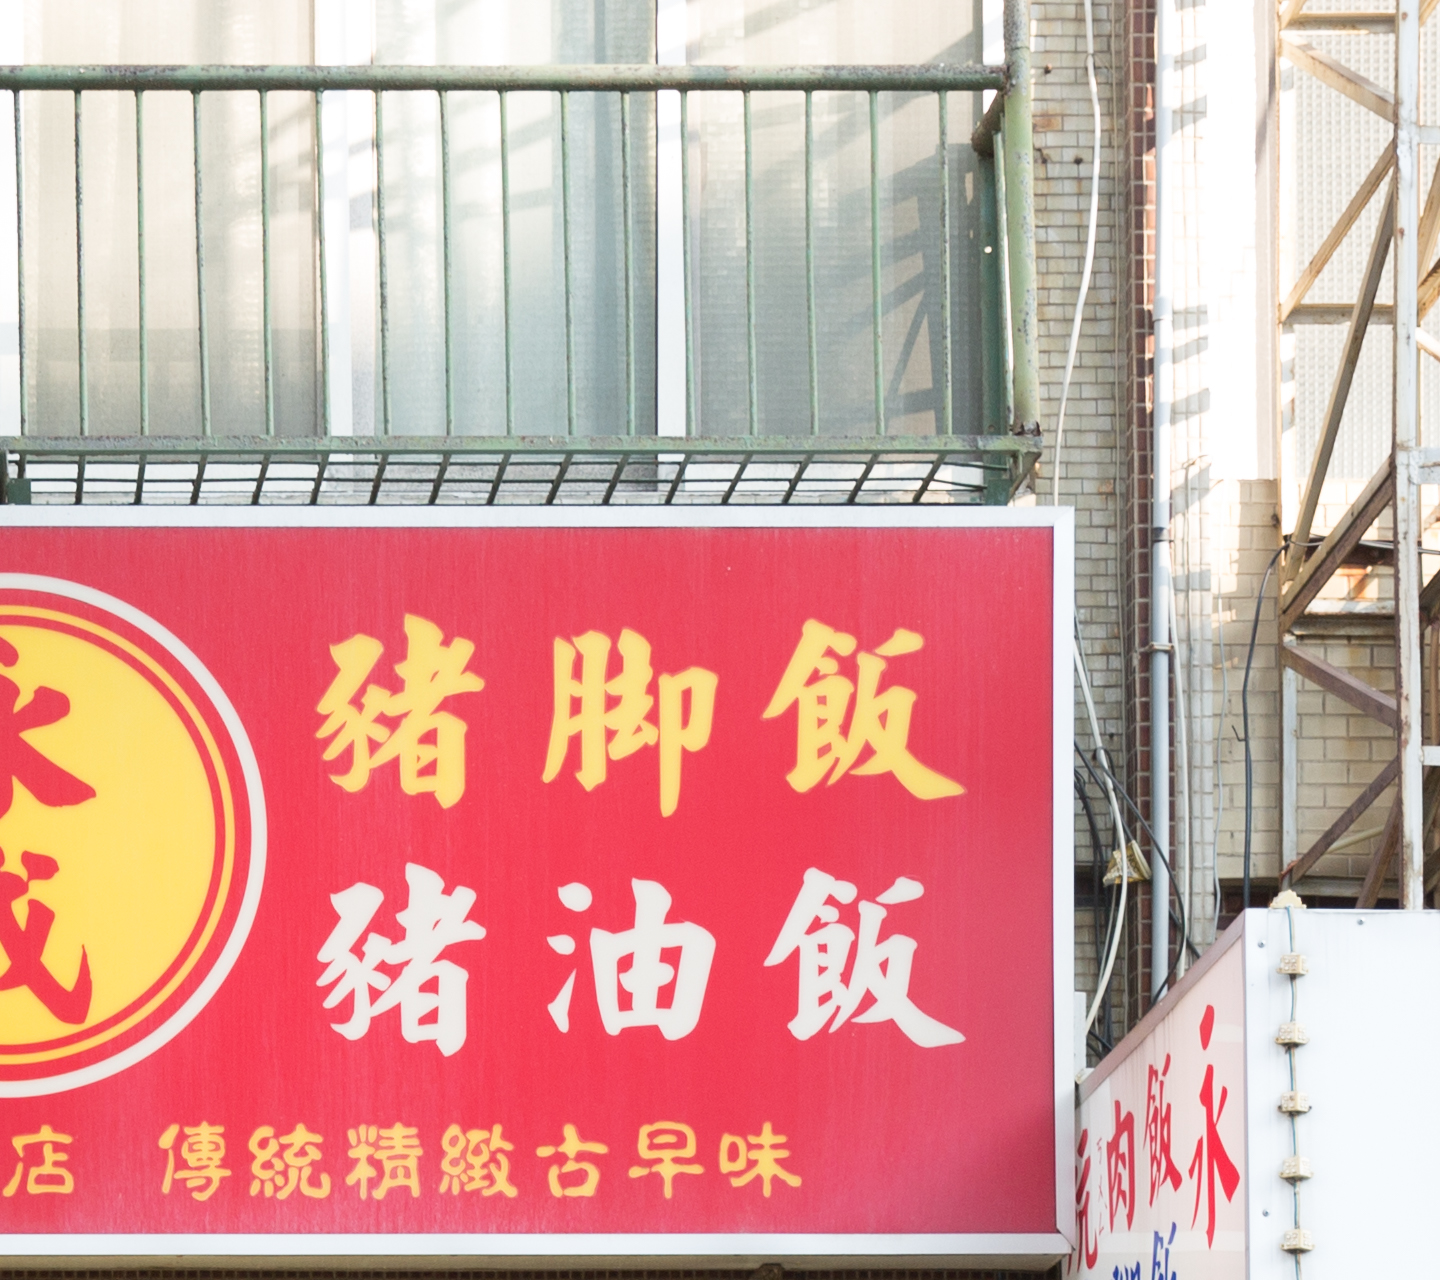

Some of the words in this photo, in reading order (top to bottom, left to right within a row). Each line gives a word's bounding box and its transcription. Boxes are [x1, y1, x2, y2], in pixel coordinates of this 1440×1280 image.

[314, 861, 967, 1057] 豬油飯
[158, 1123, 806, 1203] 傳統精緻古早味
